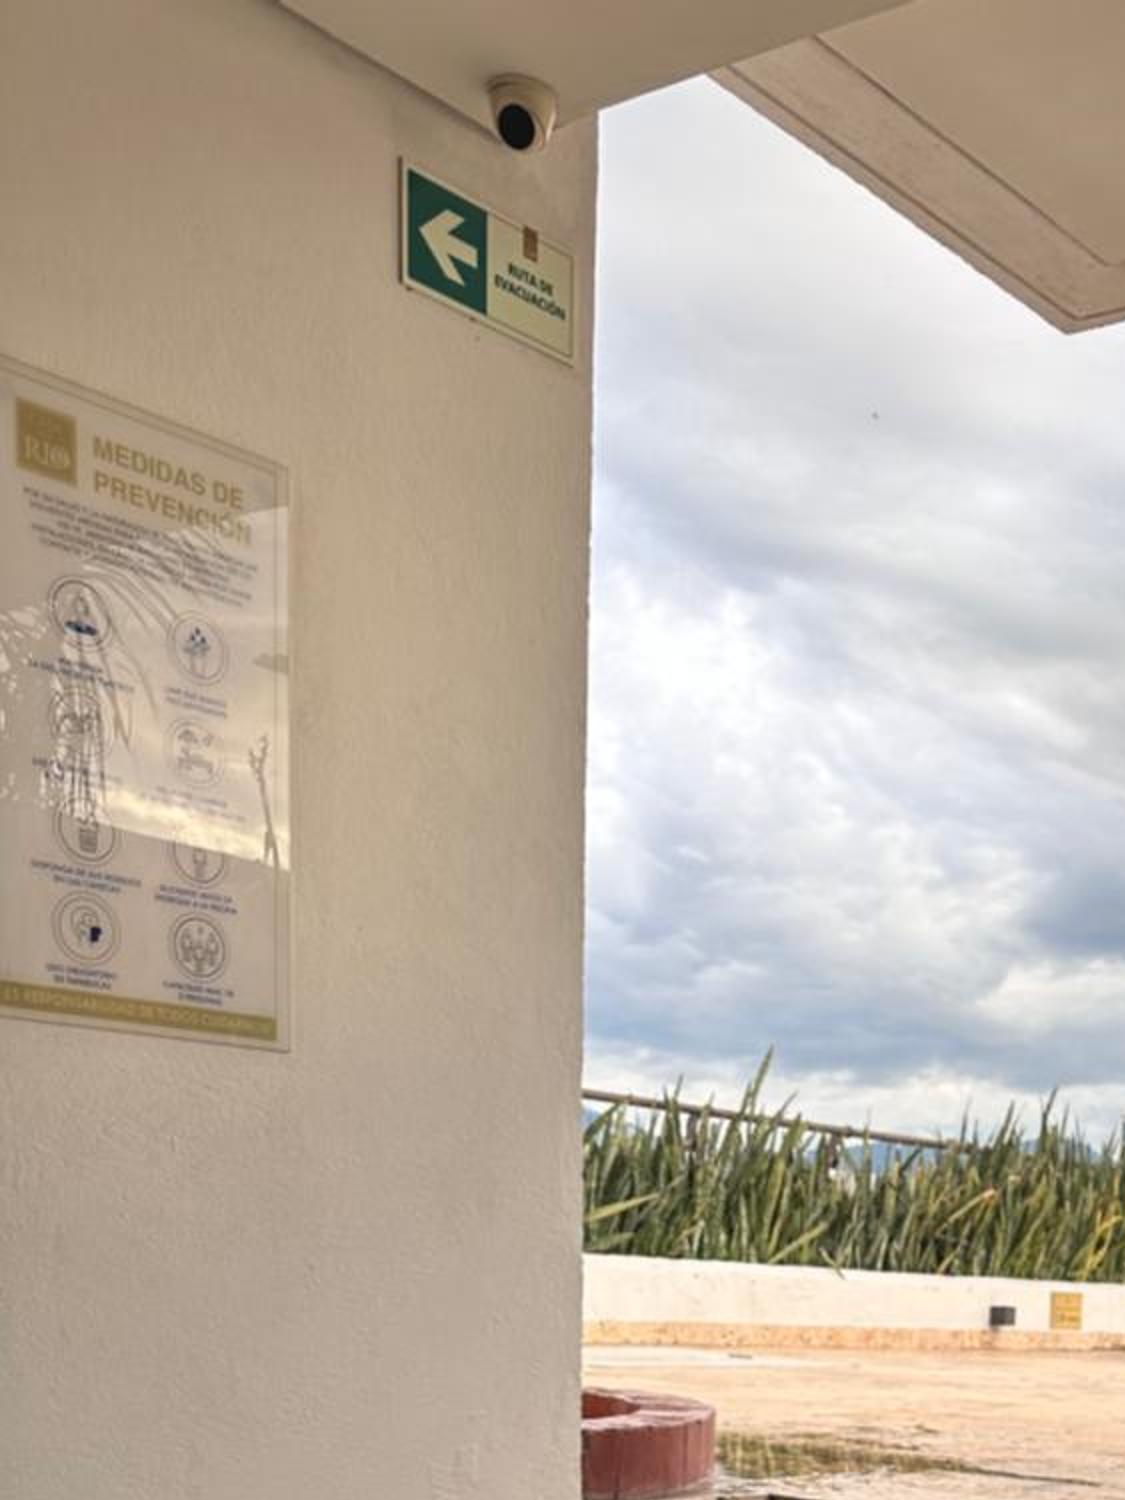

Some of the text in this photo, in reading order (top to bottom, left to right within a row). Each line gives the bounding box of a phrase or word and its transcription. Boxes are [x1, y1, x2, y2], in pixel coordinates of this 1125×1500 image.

[508, 263, 553, 297] RUTA DE
[93, 435, 207, 497] MEDIDAS
[212, 480, 243, 510] DE
[93, 469, 252, 545] PREVENCIÓN
